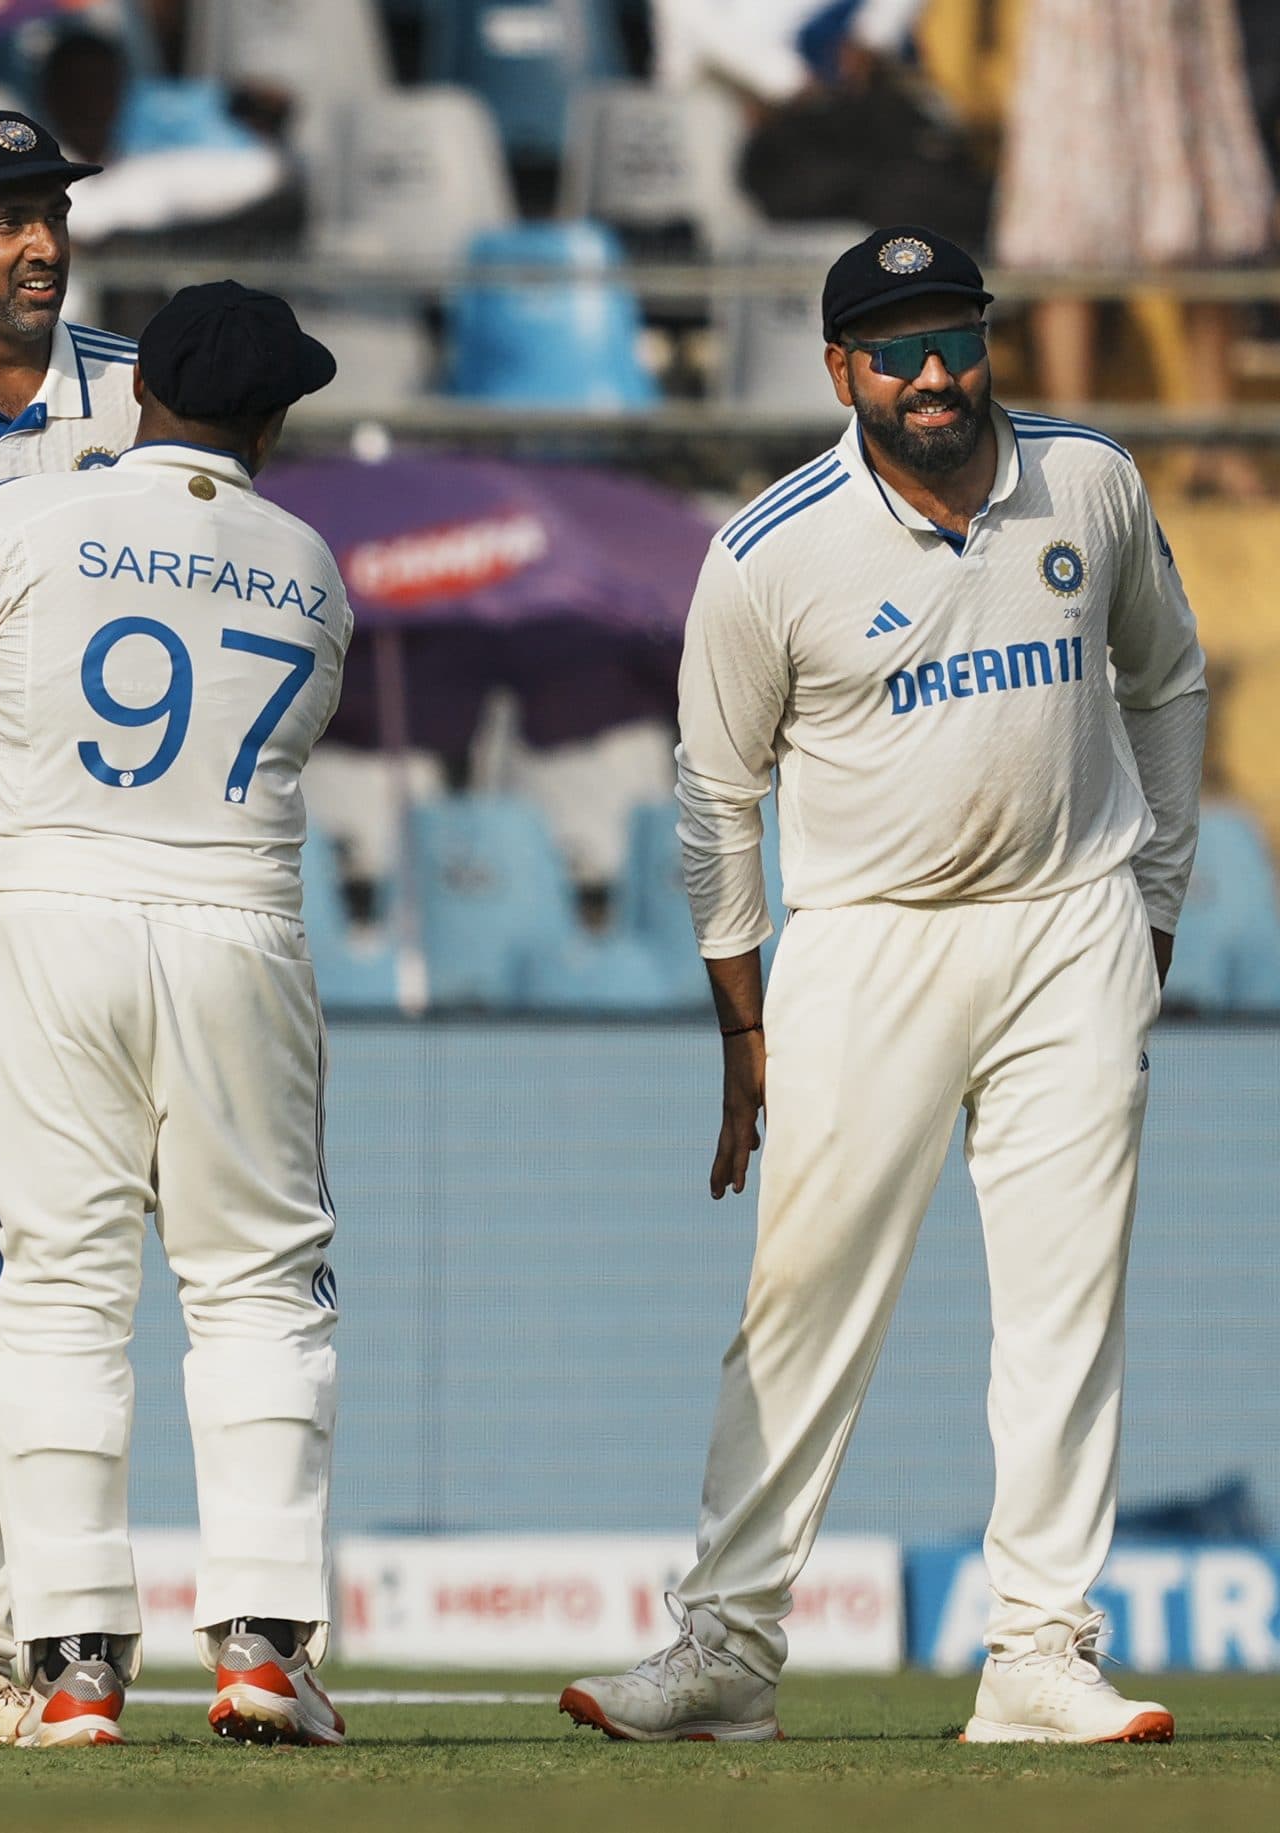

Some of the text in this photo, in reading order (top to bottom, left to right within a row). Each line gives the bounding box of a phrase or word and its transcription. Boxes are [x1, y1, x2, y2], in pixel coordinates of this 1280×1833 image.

[78, 541, 328, 625] SARFARAZ
[77, 615, 316, 805] 97
[885, 636, 1083, 715] DREAM11
